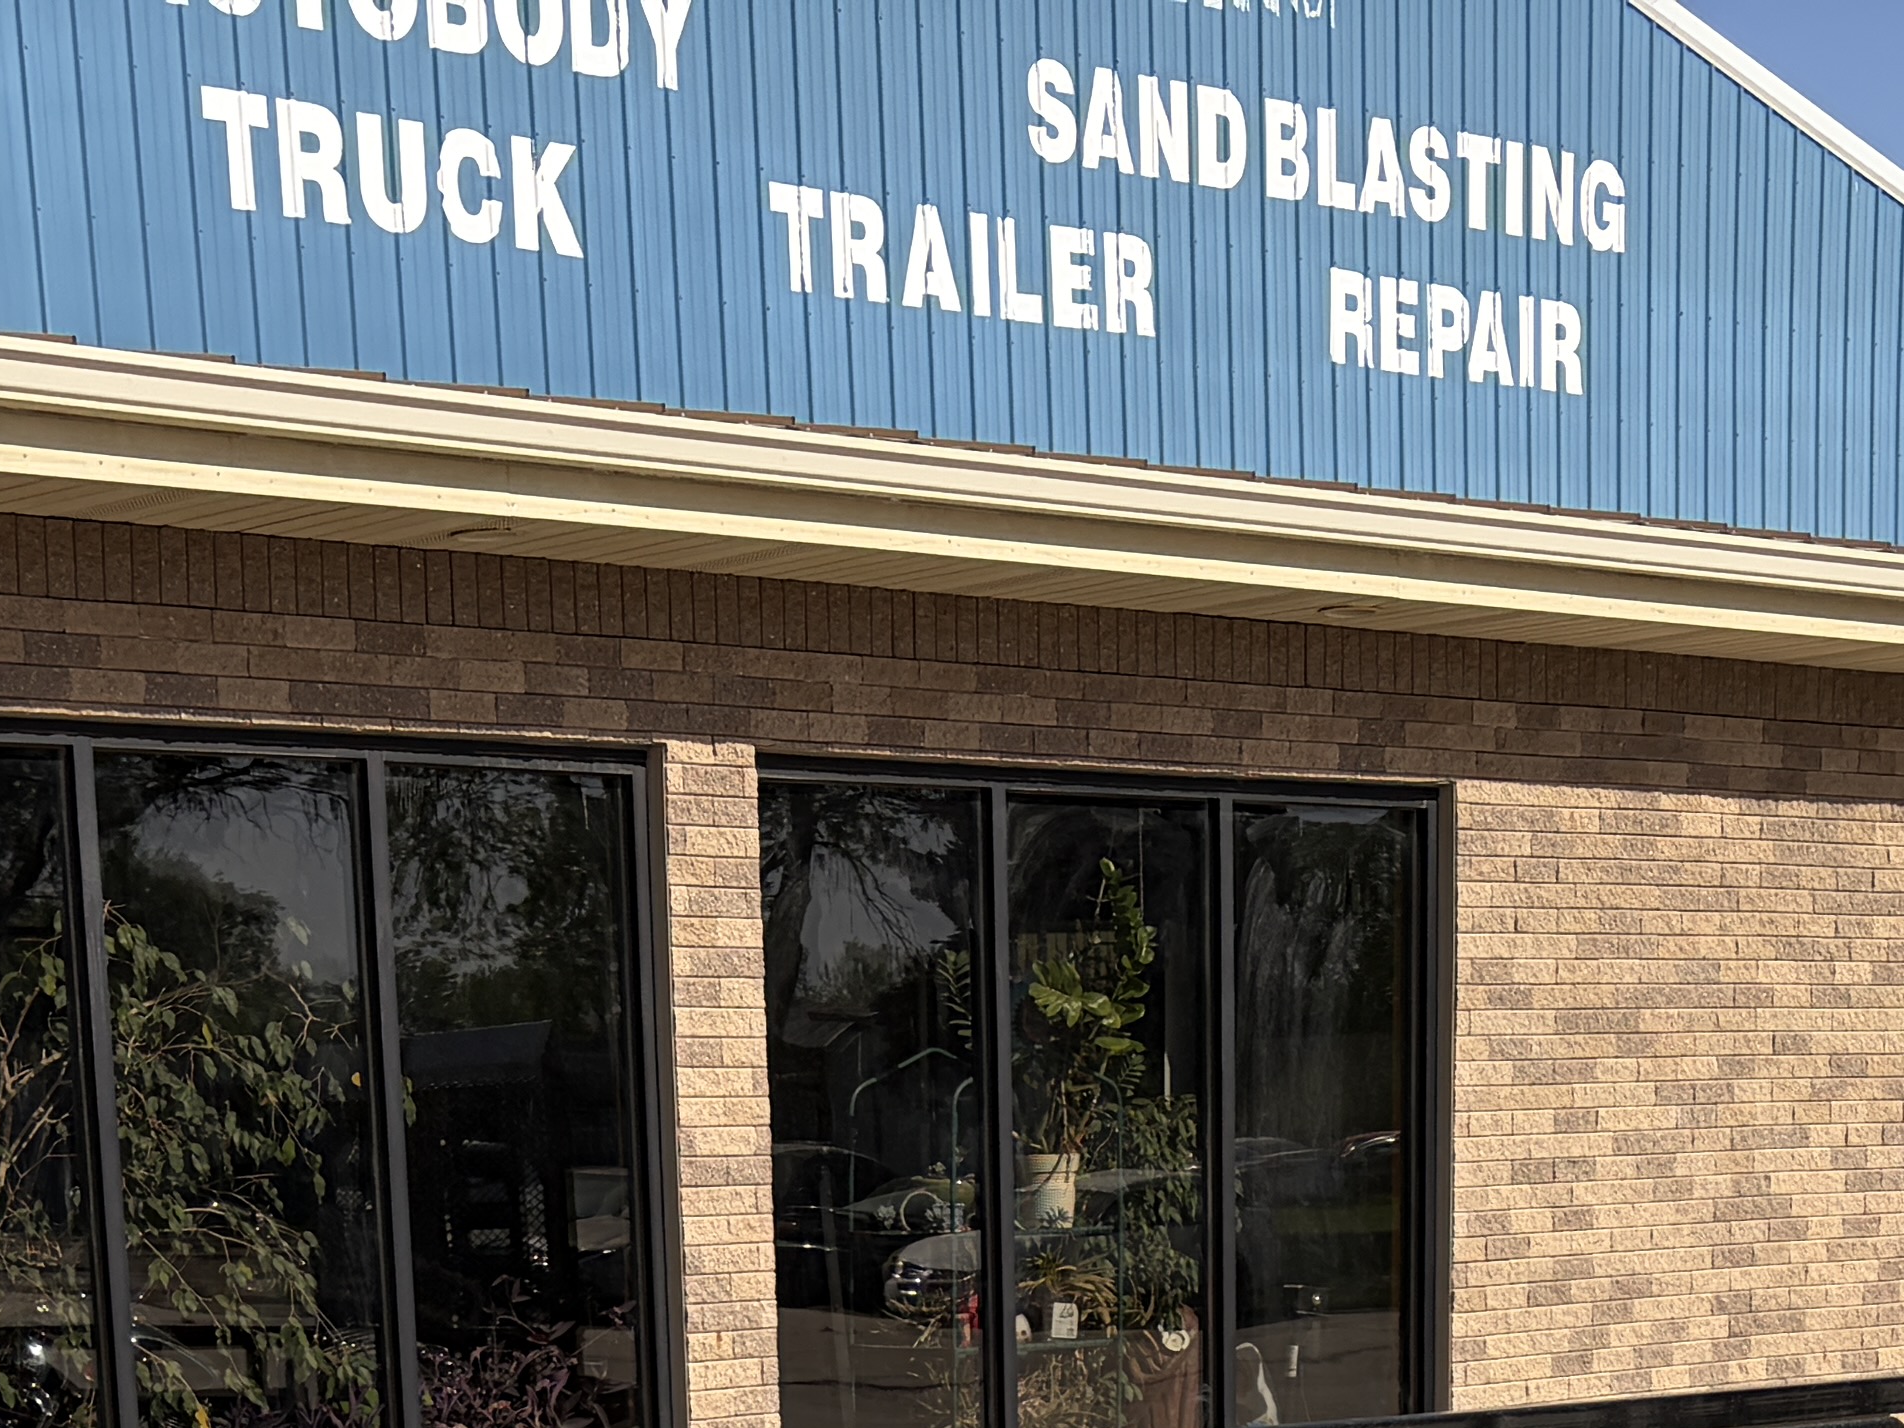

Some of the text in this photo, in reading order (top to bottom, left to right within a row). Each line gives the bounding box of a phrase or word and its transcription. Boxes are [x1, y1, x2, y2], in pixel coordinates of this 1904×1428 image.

[200, 84, 1583, 396] TRUCK TRAILER REPAIR
[1027, 57, 1626, 254] SAND BLASTING
